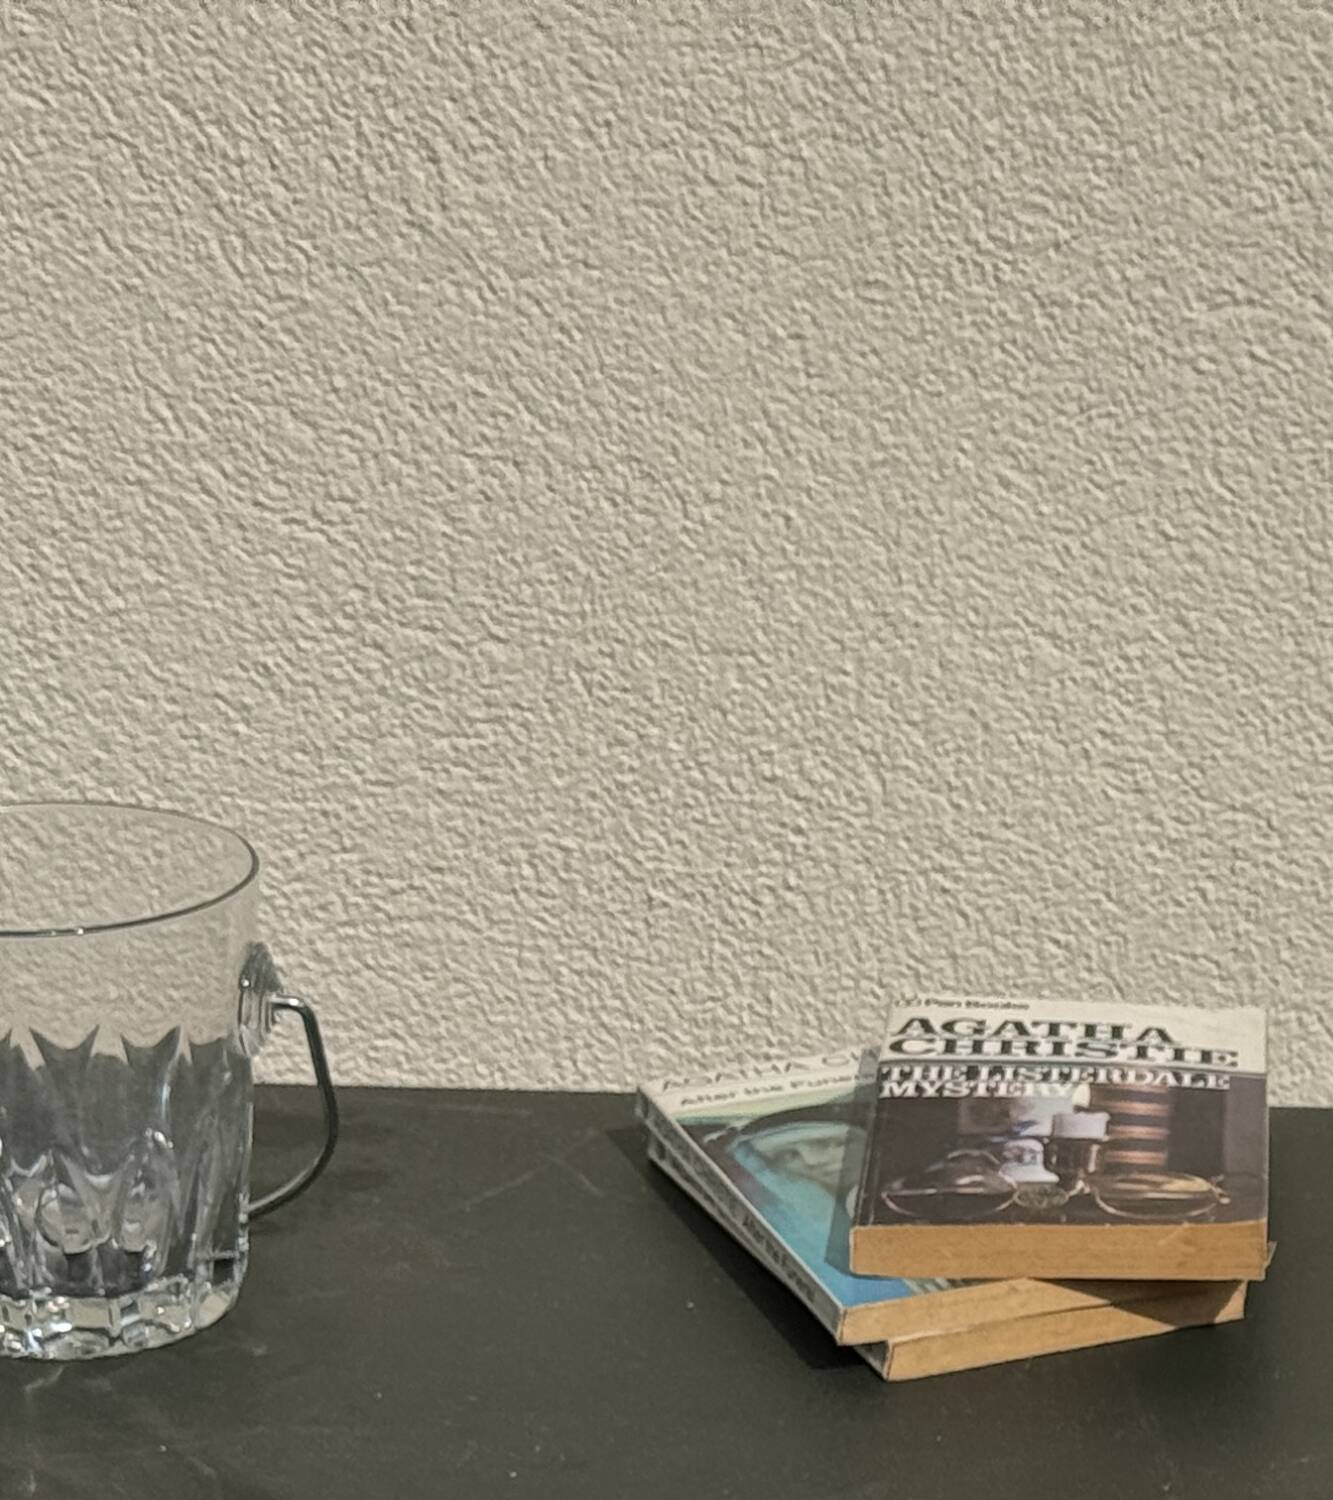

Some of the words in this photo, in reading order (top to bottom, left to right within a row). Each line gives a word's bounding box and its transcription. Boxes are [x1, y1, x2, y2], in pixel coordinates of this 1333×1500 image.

[889, 1016, 1177, 1045] AGATHA
[888, 1037, 1240, 1068] CHRISTIE
[879, 1081, 1077, 1099] MYSTERY
[880, 1064, 967, 1082] THE
[979, 1064, 1231, 1090] LISTERDALE
